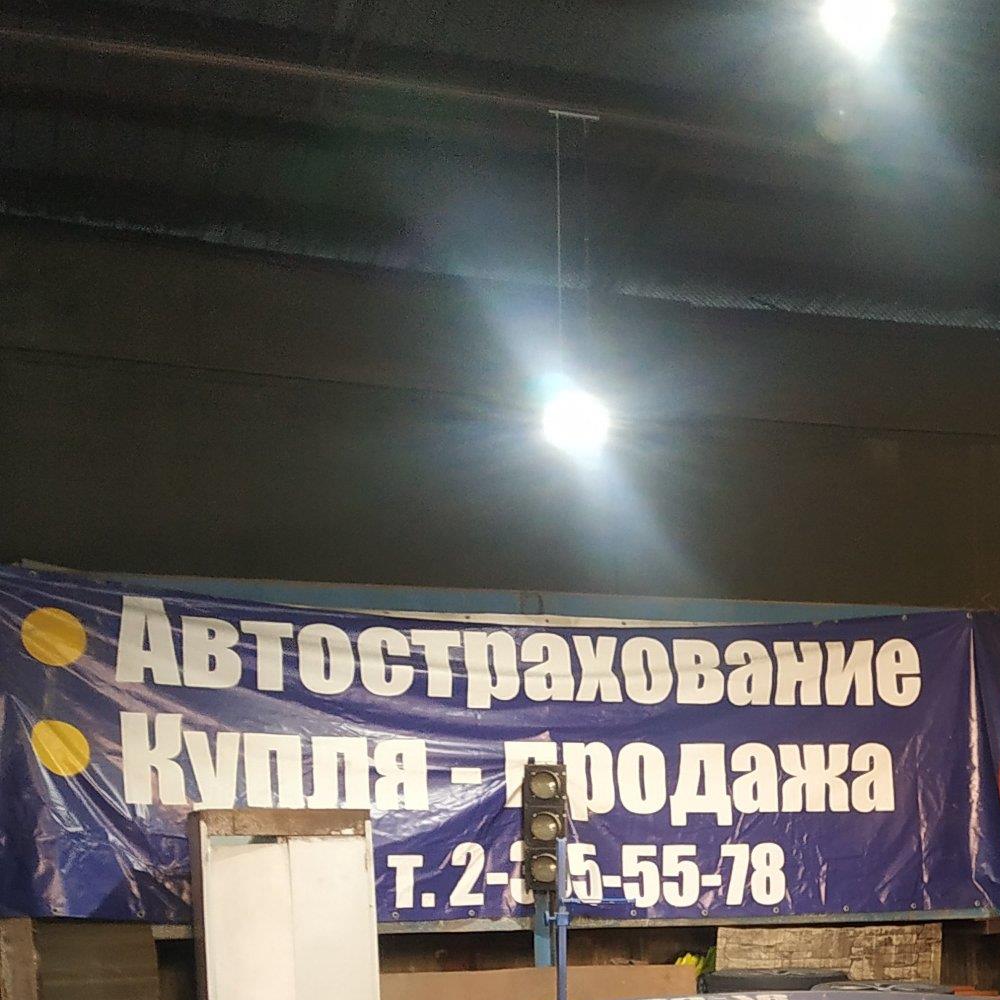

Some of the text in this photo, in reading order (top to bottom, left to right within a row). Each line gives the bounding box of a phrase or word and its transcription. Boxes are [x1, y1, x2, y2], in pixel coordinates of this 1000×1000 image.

[115, 595, 922, 709] Автострахование
[120, 710, 429, 812] Купля
[449, 841, 787, 909] 2-35-55-78
